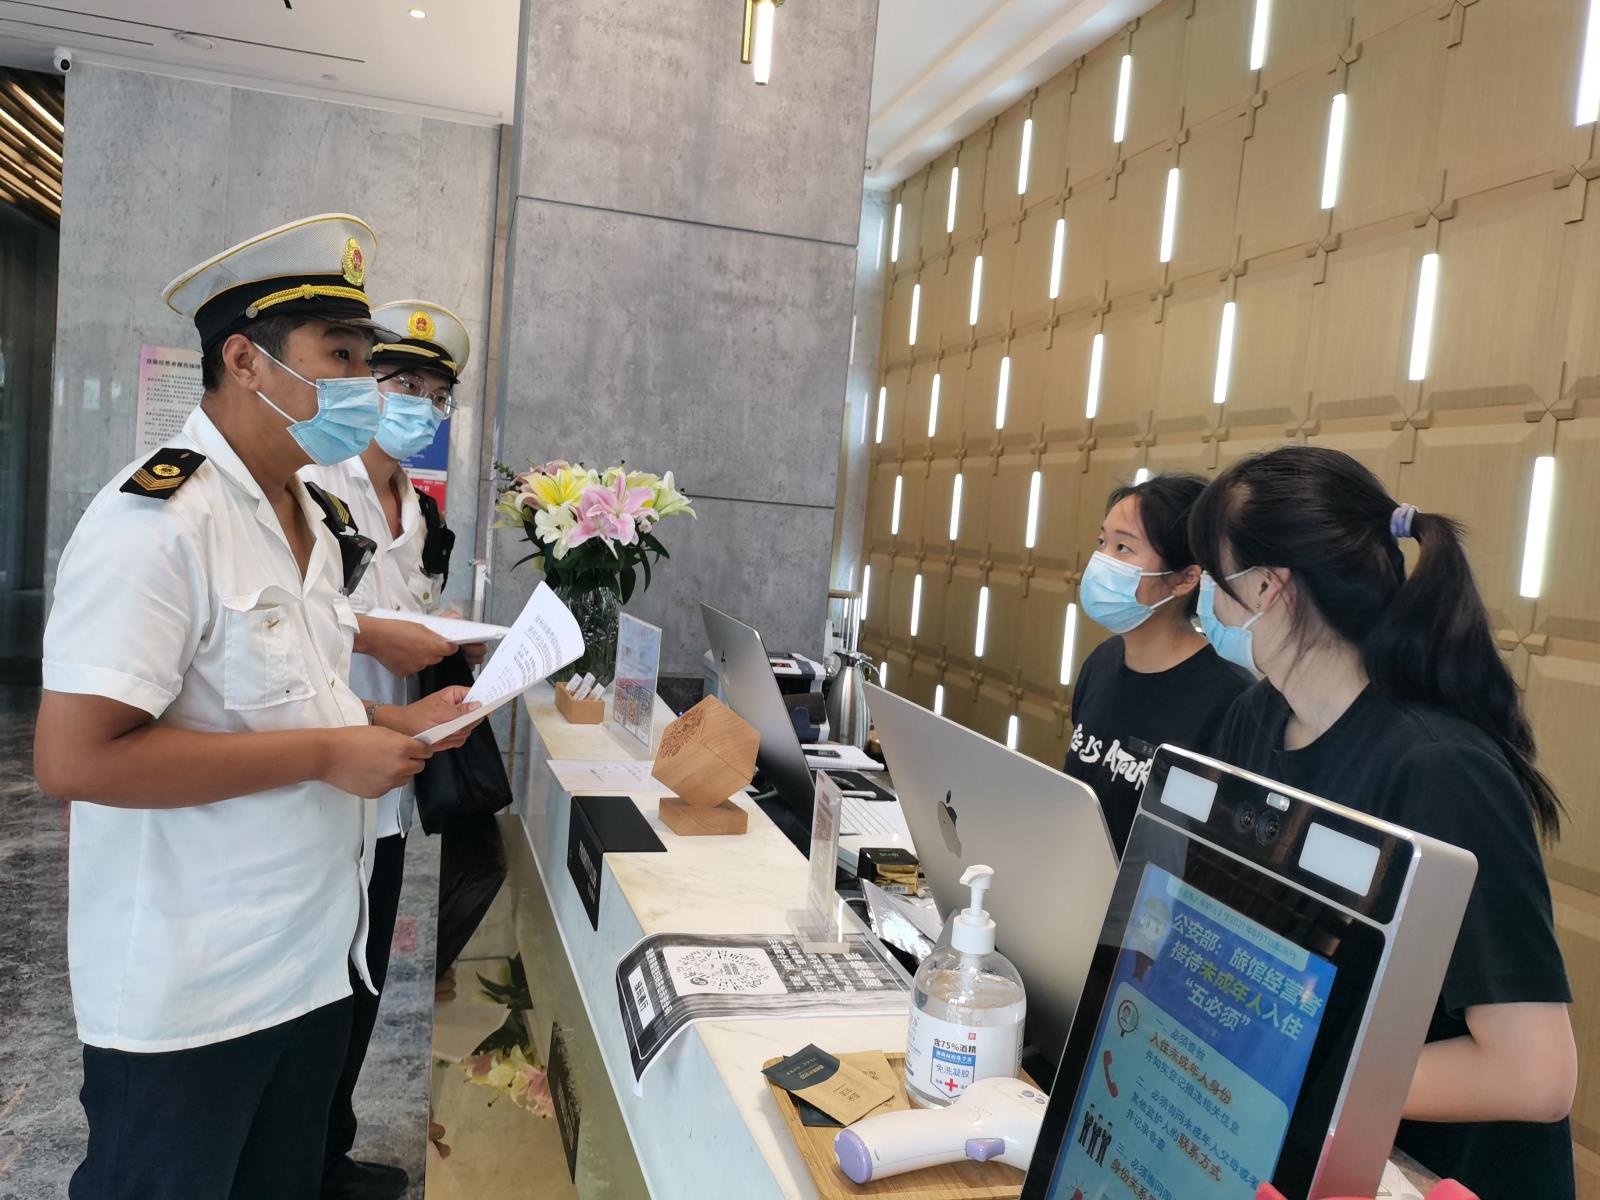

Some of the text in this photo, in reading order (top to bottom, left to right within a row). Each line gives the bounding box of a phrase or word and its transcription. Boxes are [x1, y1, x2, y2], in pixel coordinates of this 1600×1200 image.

[1169, 941, 1304, 1040] 接待未成年人入住
[936, 1063, 970, 1078] 免洗凝胶
[1148, 1031, 1233, 1105] 入住未成年人身份
